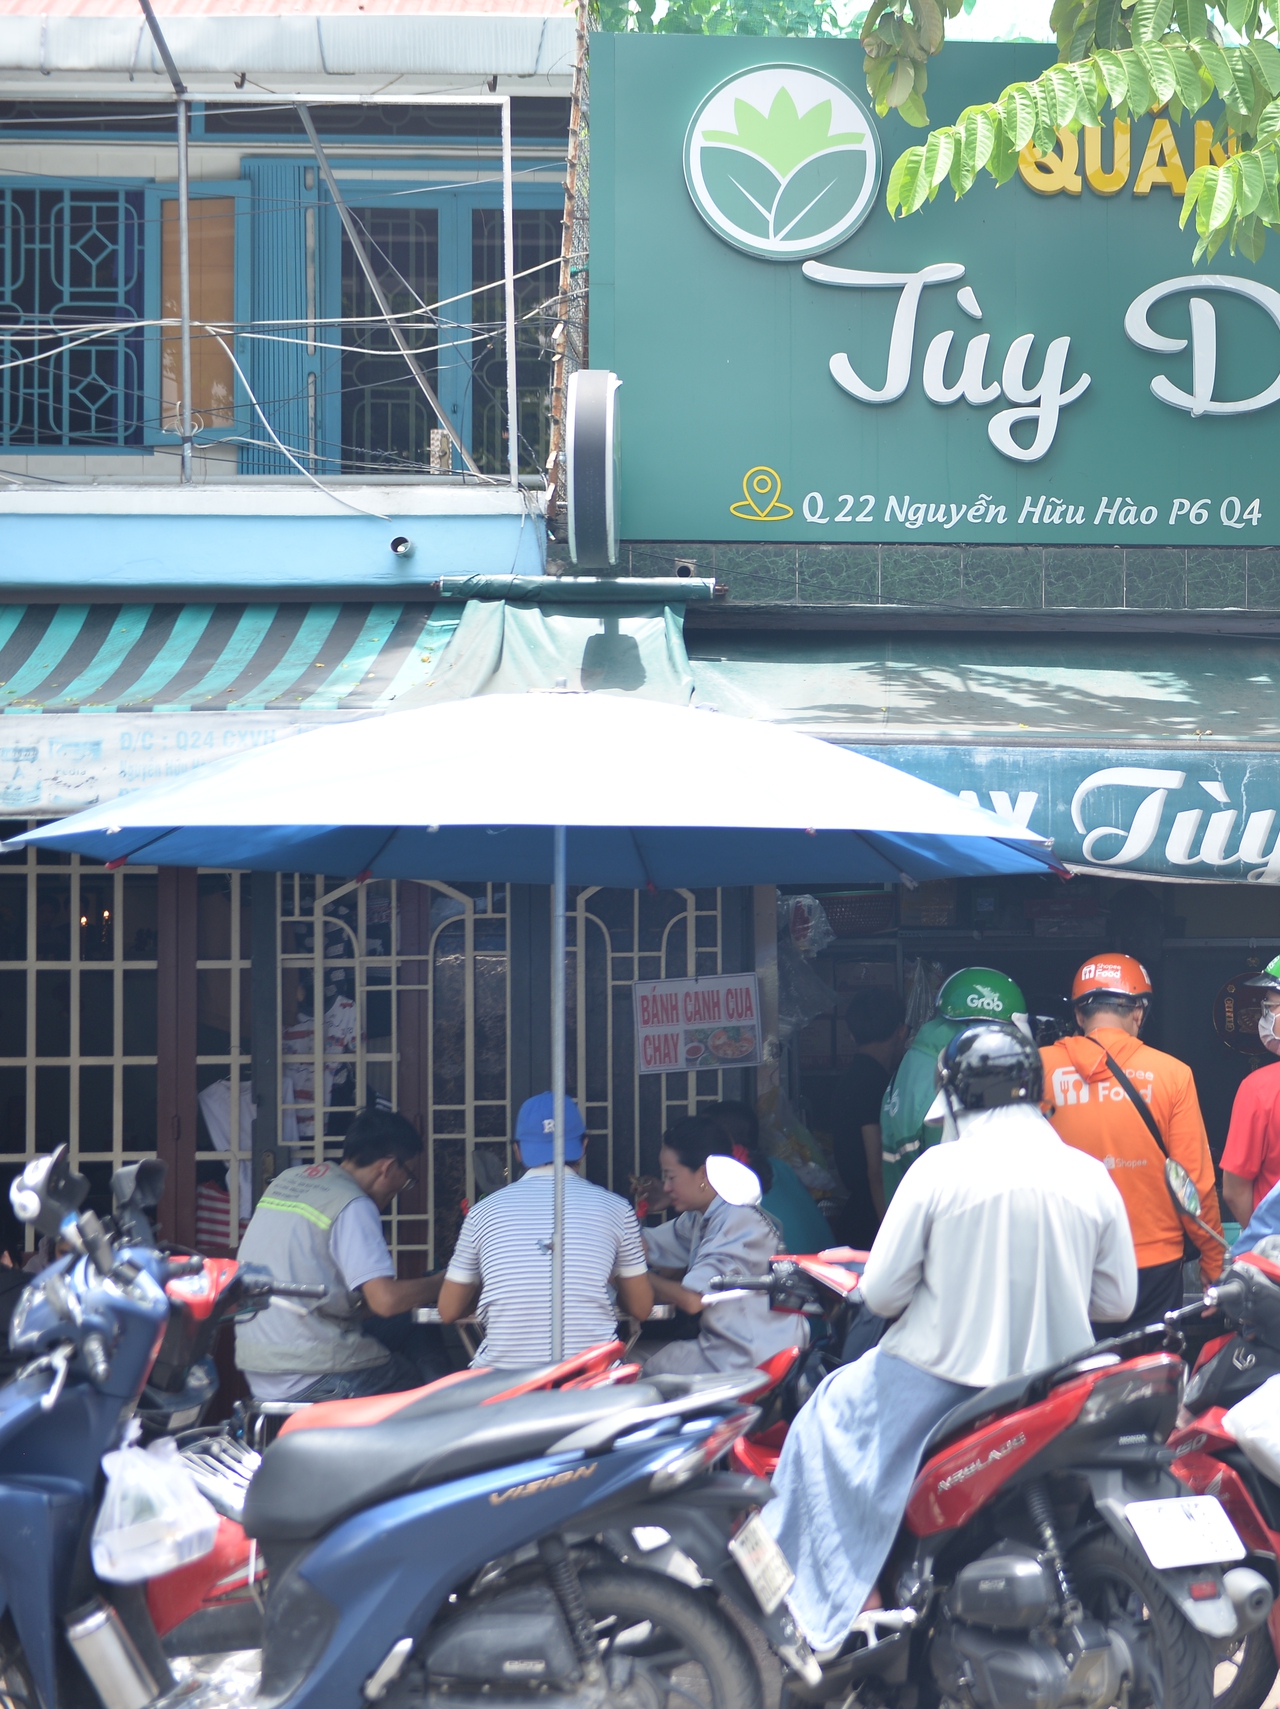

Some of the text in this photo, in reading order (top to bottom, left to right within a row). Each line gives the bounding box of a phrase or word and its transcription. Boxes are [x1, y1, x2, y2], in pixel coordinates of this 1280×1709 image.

[801, 259, 1092, 462] Tùy
[883, 493, 1009, 530] Nguyễn
[1017, 495, 1086, 526] Hữu
[1093, 495, 1159, 526] Hào
[1168, 497, 1212, 526] P6
[1219, 496, 1264, 530] Q4
[1095, 969, 1122, 979] Food
[640, 985, 755, 1029] BÁNH CANH CUA
[966, 993, 1004, 1012] Grab
[643, 1032, 680, 1069] CHAY
[1097, 1081, 1153, 1104] Fod
[1115, 1157, 1148, 1170] Shopee
